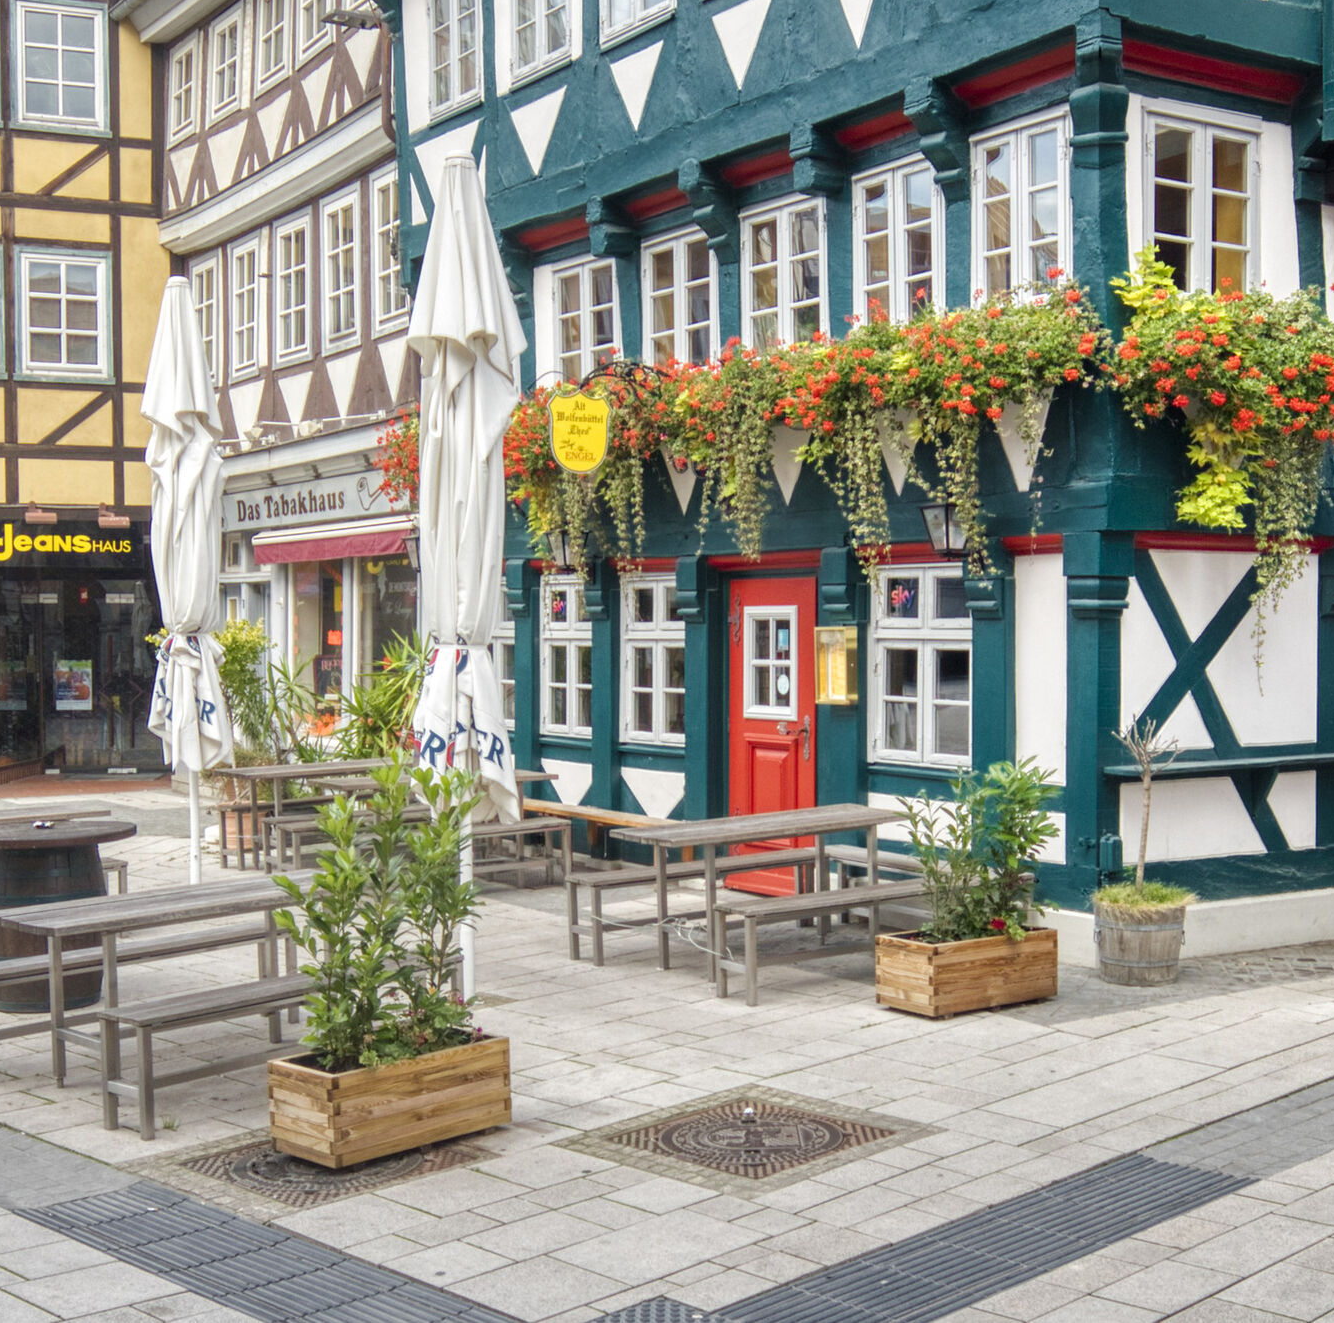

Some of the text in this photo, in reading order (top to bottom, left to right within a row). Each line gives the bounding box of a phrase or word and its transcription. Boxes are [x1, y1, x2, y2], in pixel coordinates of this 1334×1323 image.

[573, 400, 586, 411] Alt
[237, 488, 345, 522] Das Tabakhaus
[891, 585, 915, 609] sky
